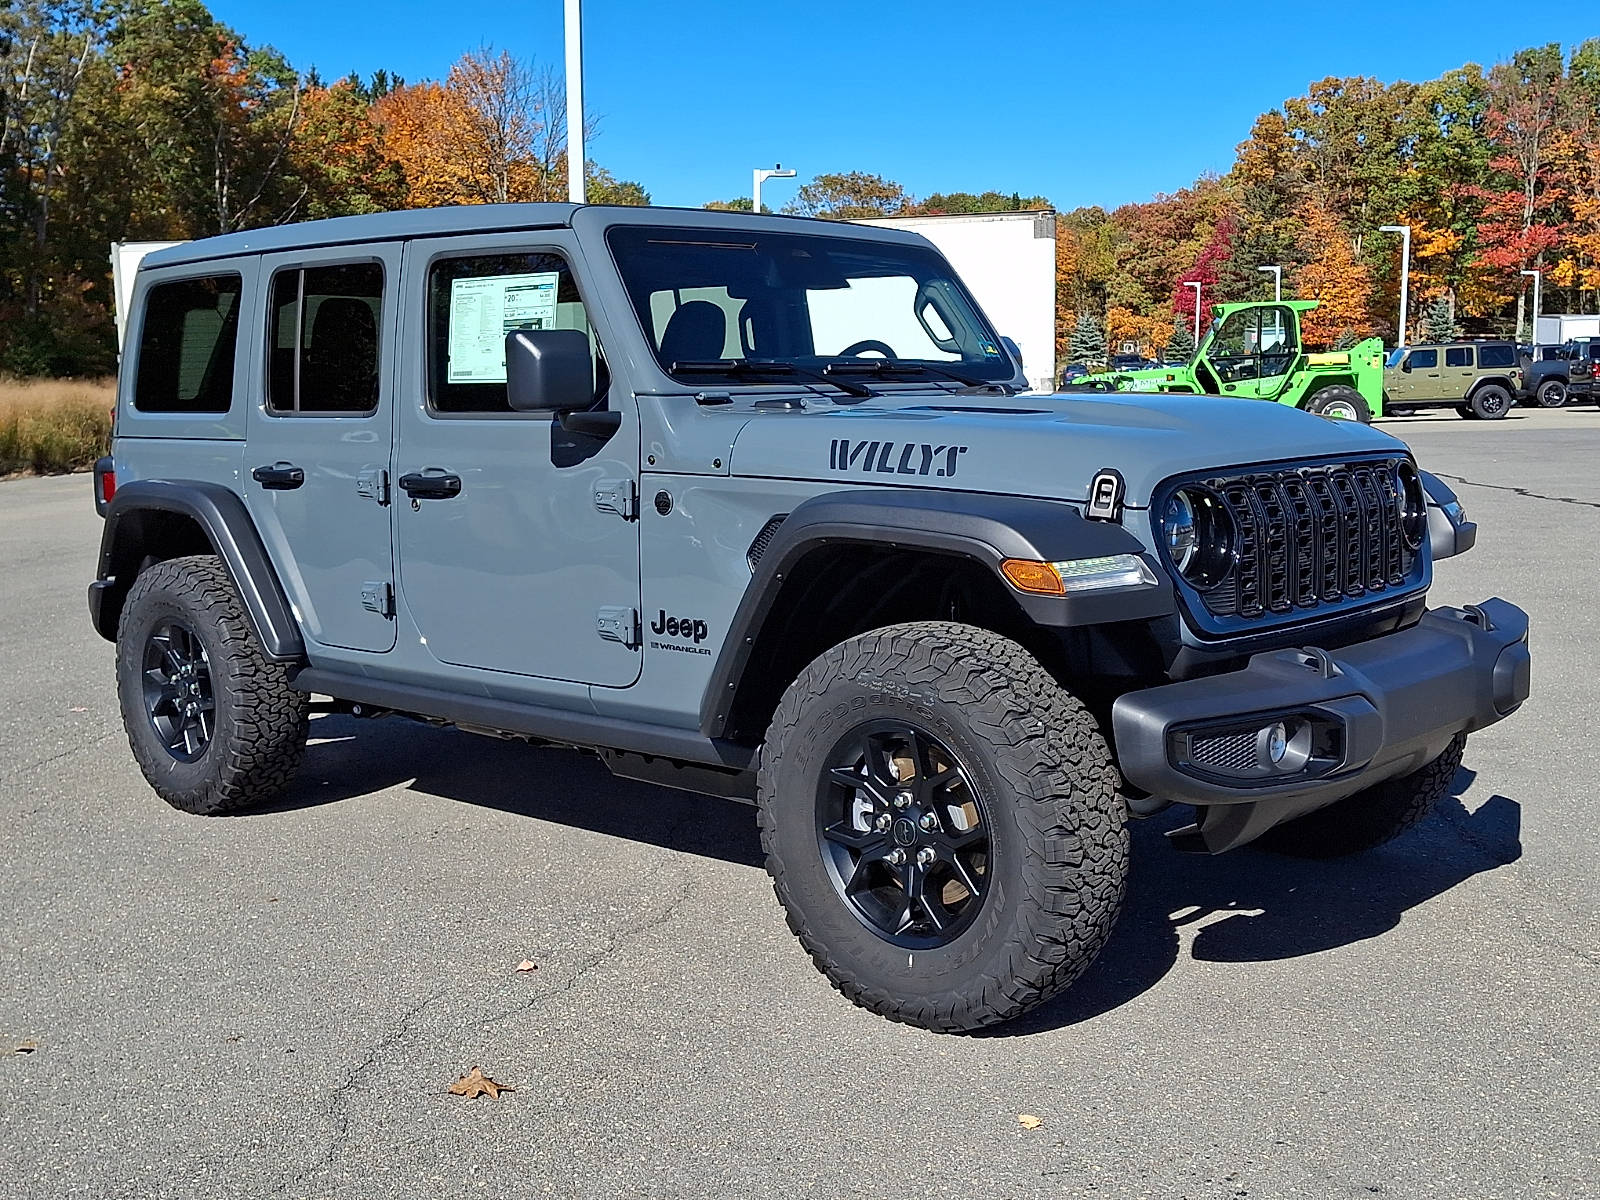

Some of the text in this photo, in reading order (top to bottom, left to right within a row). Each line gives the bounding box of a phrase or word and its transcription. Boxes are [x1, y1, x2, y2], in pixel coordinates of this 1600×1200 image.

[830, 439, 968, 477] WILLYS
[650, 608, 709, 645] Jeep
[659, 642, 712, 656] WRANGLER
